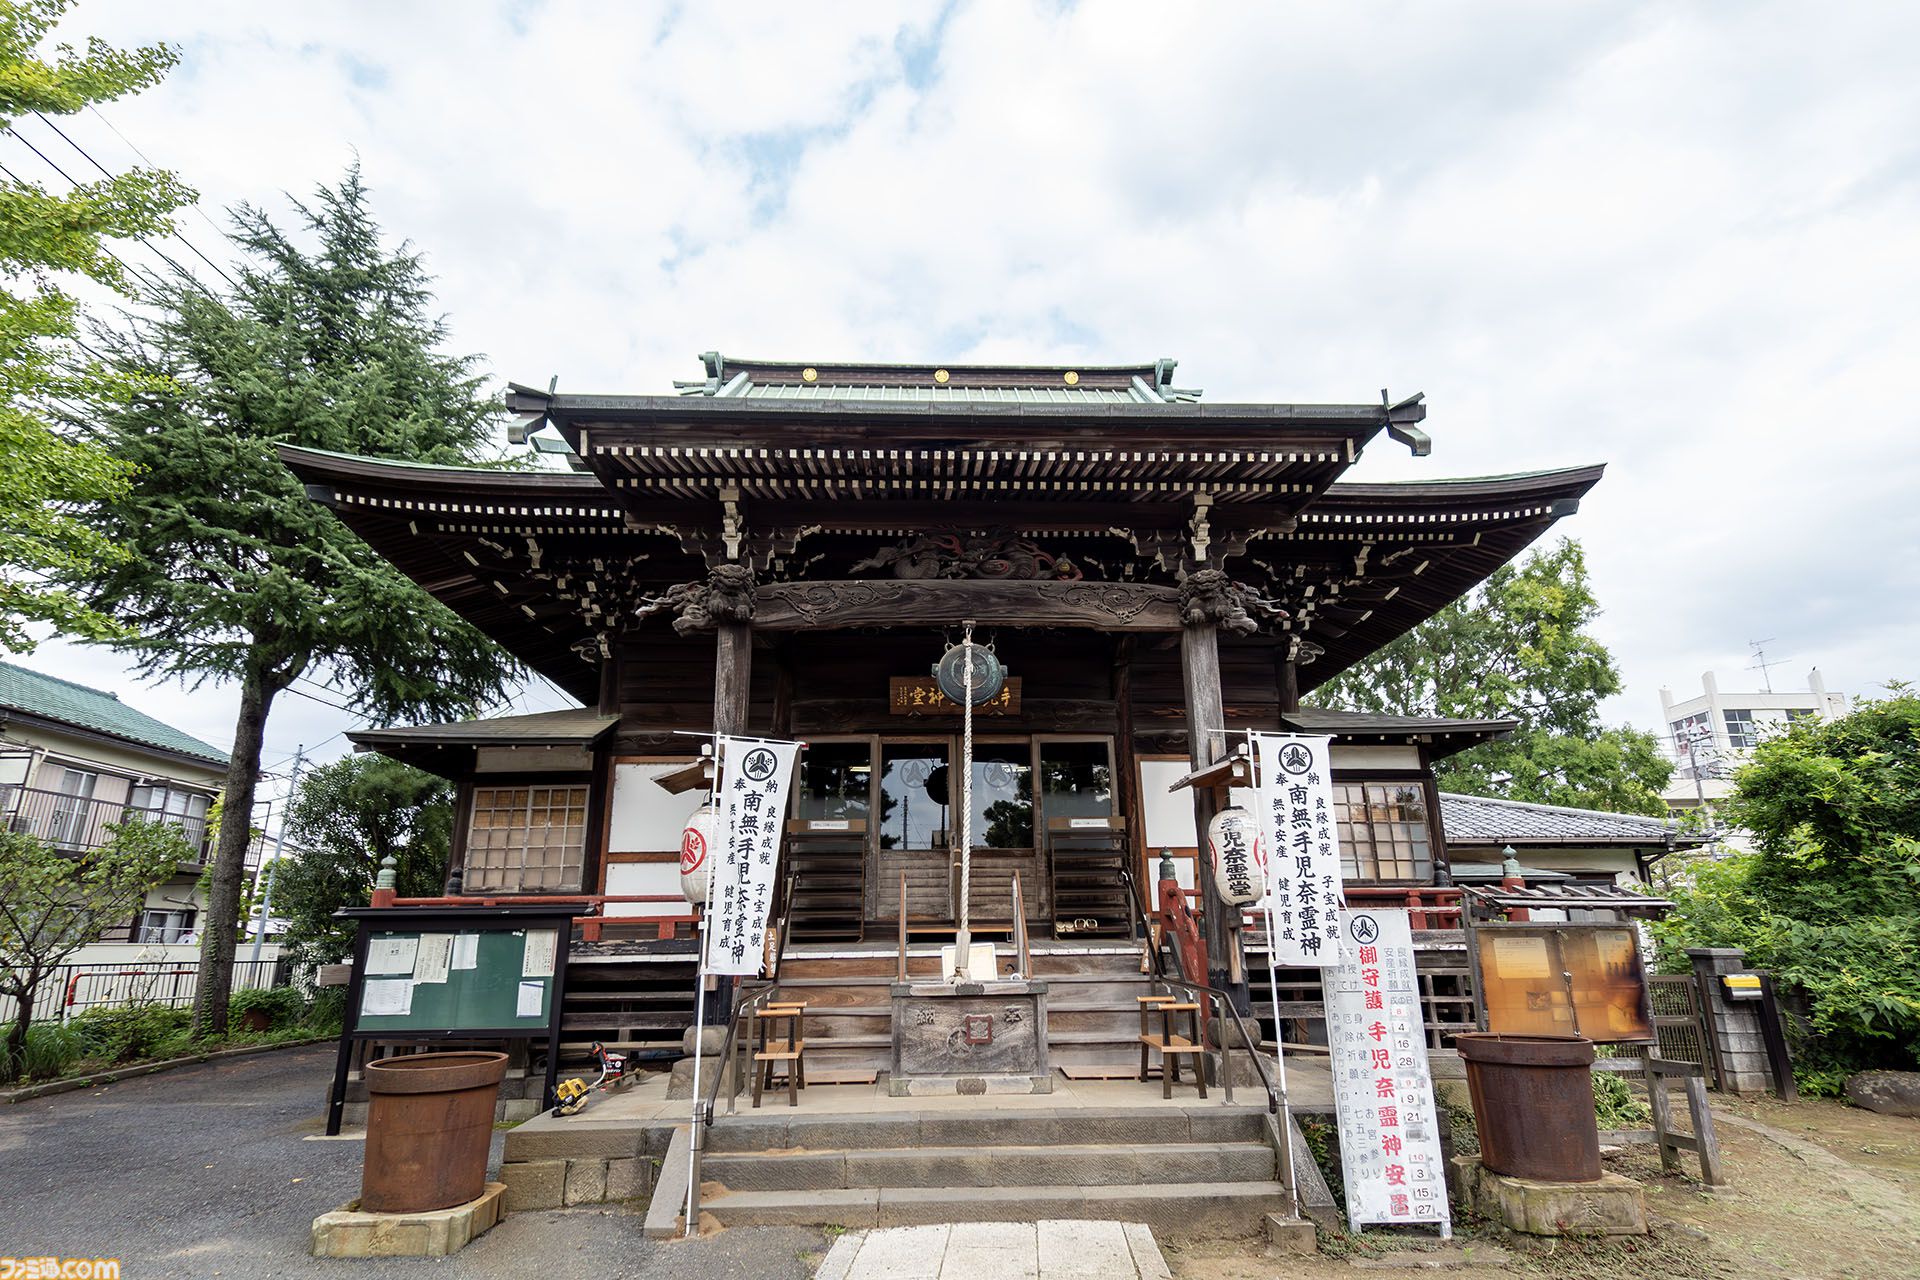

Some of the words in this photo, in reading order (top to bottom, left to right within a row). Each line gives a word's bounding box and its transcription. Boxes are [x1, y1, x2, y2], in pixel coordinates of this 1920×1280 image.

[733, 778, 778, 793] 奉納
[1275, 772, 1320, 786] 奉納
[759, 806, 776, 865] 良縁成就
[1272, 798, 1288, 858] 無事安産
[1316, 797, 1332, 857] 良縁成就
[1221, 816, 1252, 897] 手児奈霊堂
[1288, 783, 1322, 957] 南無手児奈霊神
[719, 885, 735, 949] 健児育成
[750, 883, 767, 947] 子宝成就
[1278, 877, 1295, 941] 健児育成
[1322, 875, 1340, 940] 子宝成就
[1398, 1023, 1405, 1031] 4
[1398, 1040, 1410, 1049] 16
[1399, 1057, 1413, 1067] 28
[1407, 1112, 1420, 1122] 21
[1416, 1169, 1424, 1178] 3
[1416, 1188, 1429, 1197] 15
[1418, 1204, 1431, 1214] 27
